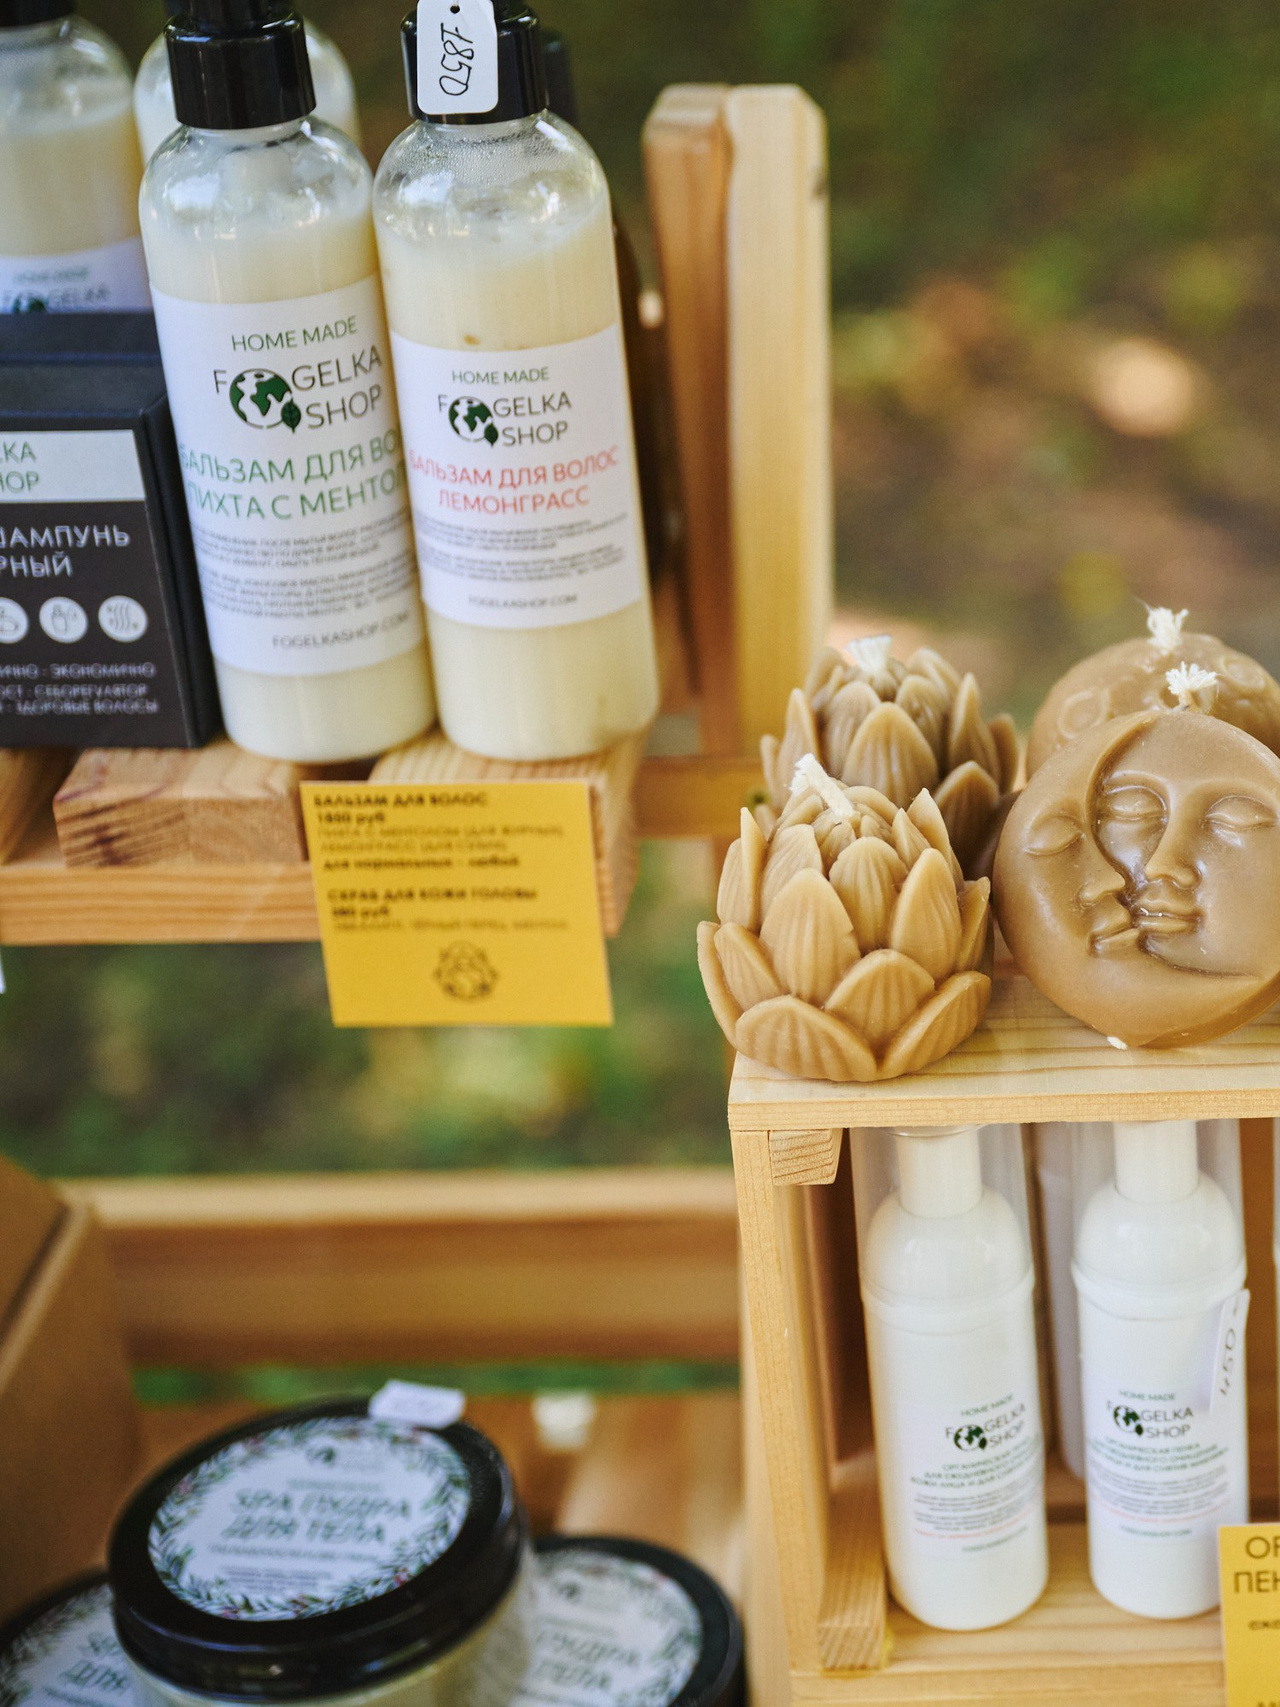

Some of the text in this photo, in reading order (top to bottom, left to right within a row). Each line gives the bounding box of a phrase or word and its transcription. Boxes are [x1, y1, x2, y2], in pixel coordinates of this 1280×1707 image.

[438, 22, 474, 96] 1850
[232, 316, 358, 352] HOME MADE
[451, 367, 550, 385] HOME MADE
[306, 384, 382, 430] SHOP
[502, 421, 569, 447] SHOP
[0, 441, 37, 464] KA
[303, 443, 365, 485] ДЛЯ
[369, 428, 400, 463] ВО
[408, 446, 620, 490] БАЛЬЗАМ ДЛЯ ВОЛОС
[187, 460, 405, 521] ПИХТА С МЕНТО
[439, 485, 590, 515] ЛЕМОНГРАСС
[313, 791, 489, 808] БАЛЬЗАМ ДЛЯ ВОЛОС
[383, 888, 414, 901] ДЛЯ
[988, 1419, 1025, 1449] SHOP
[1146, 1424, 1192, 1439] SHOP
